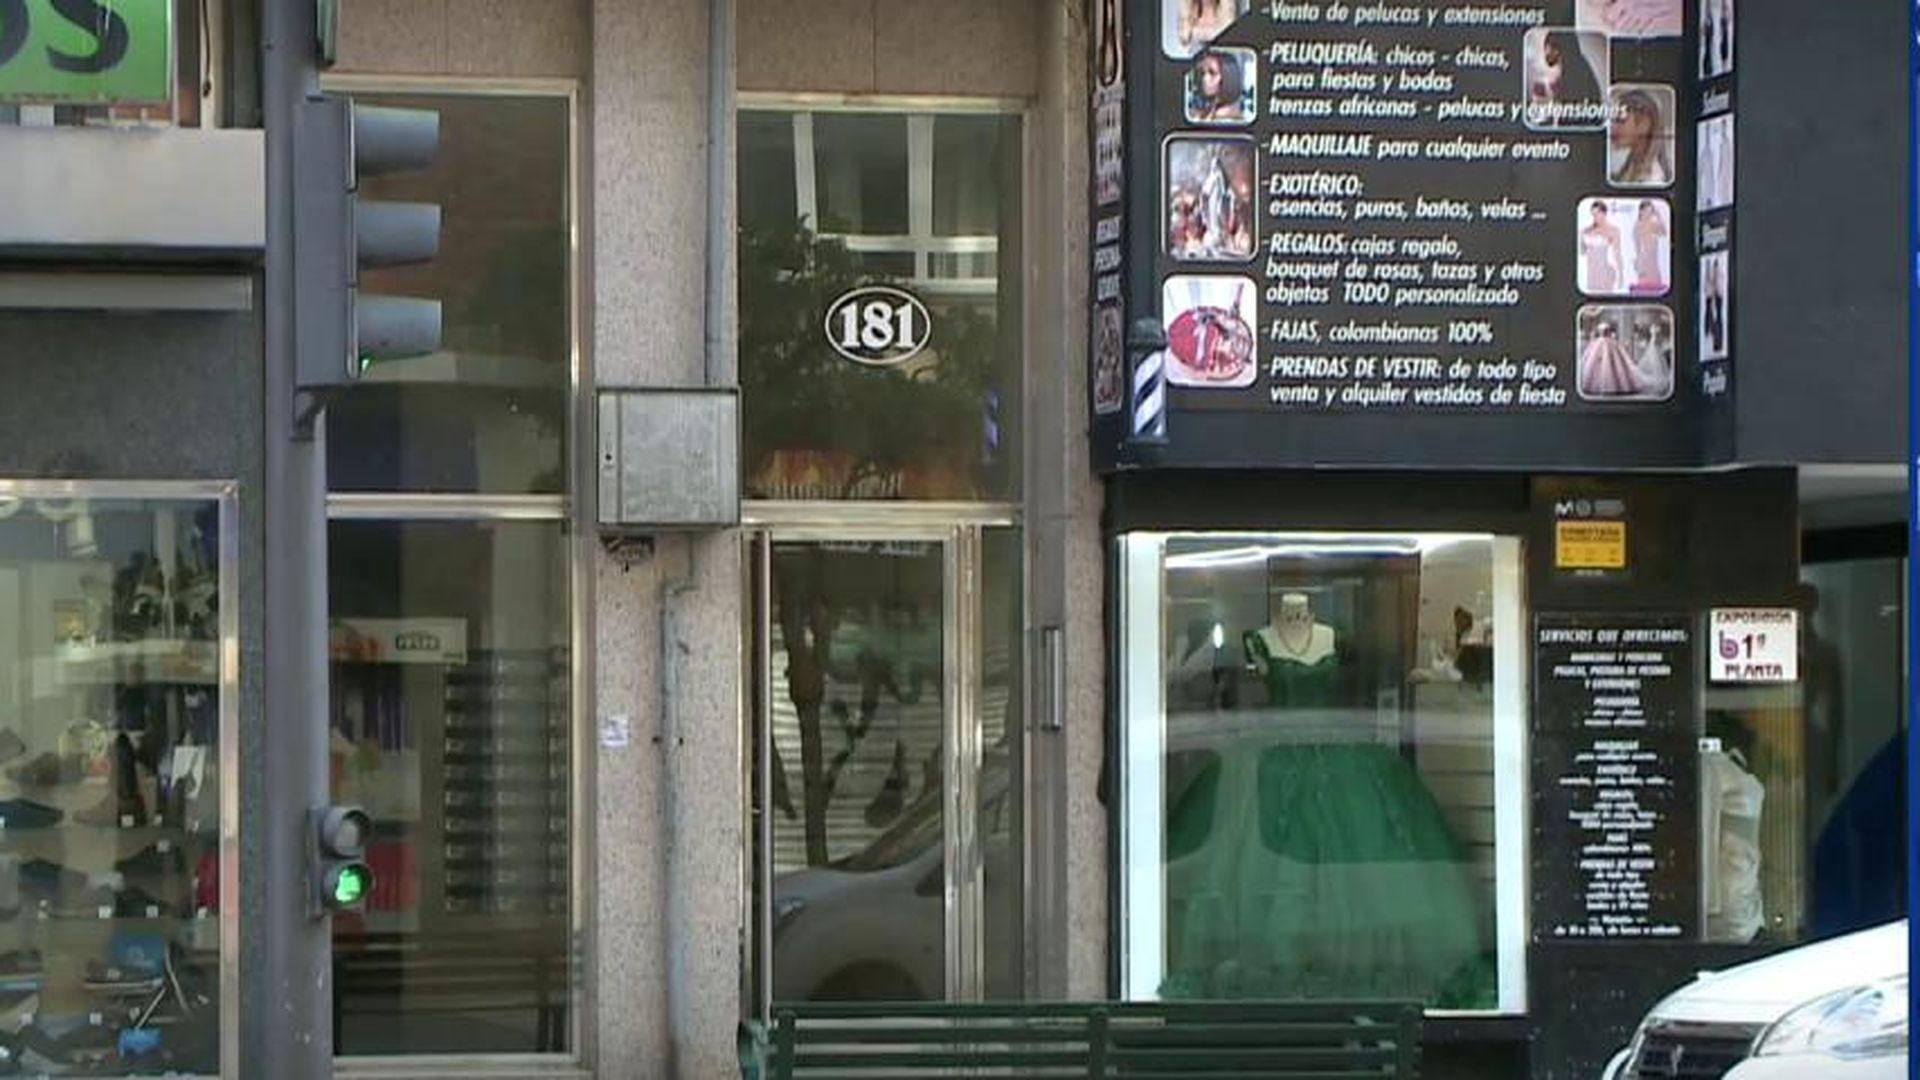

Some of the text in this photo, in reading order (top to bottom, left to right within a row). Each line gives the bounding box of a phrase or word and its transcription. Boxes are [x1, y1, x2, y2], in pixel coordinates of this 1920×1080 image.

[1326, 4, 1348, 22] de
[1354, 3, 1420, 28] pelucas
[1426, 8, 1436, 27] y
[1443, 5, 1545, 25] extensiones
[1385, 45, 1435, 65] chicos
[1455, 45, 1510, 70] chicas,
[1272, 67, 1453, 94] para fiestas y bodas
[1270, 96, 1332, 115] trenzas
[1338, 94, 1417, 117] africanas
[1438, 96, 1504, 120] pelucas
[1510, 103, 1521, 121] y
[1376, 139, 1418, 159] para
[1425, 135, 1505, 161] cualquier
[1511, 139, 1569, 157] evento
[1270, 199, 1348, 220] esencias,
[1355, 201, 1407, 223] puros,
[1481, 199, 1526, 219] velas
[1350, 237, 1395, 257] cajas
[1401, 235, 1463, 258] regalo,
[1266, 258, 1543, 283] bouquet de rosas, tazas y otros
[1266, 283, 1520, 307] objetos TODO personalizado
[839, 300, 915, 348] 181
[1329, 320, 1439, 342] colombianas
[1447, 323, 1493, 342] 100%
[1355, 358, 1375, 378] DE
[1384, 359, 1441, 379] VESTIR:
[1448, 359, 1472, 379] de
[1478, 359, 1516, 379] todo
[1523, 359, 1556, 382] tipo
[1270, 382, 1565, 405] venta y alquiler vestidos de fiesta
[1725, 664, 1783, 676] PLANTA
